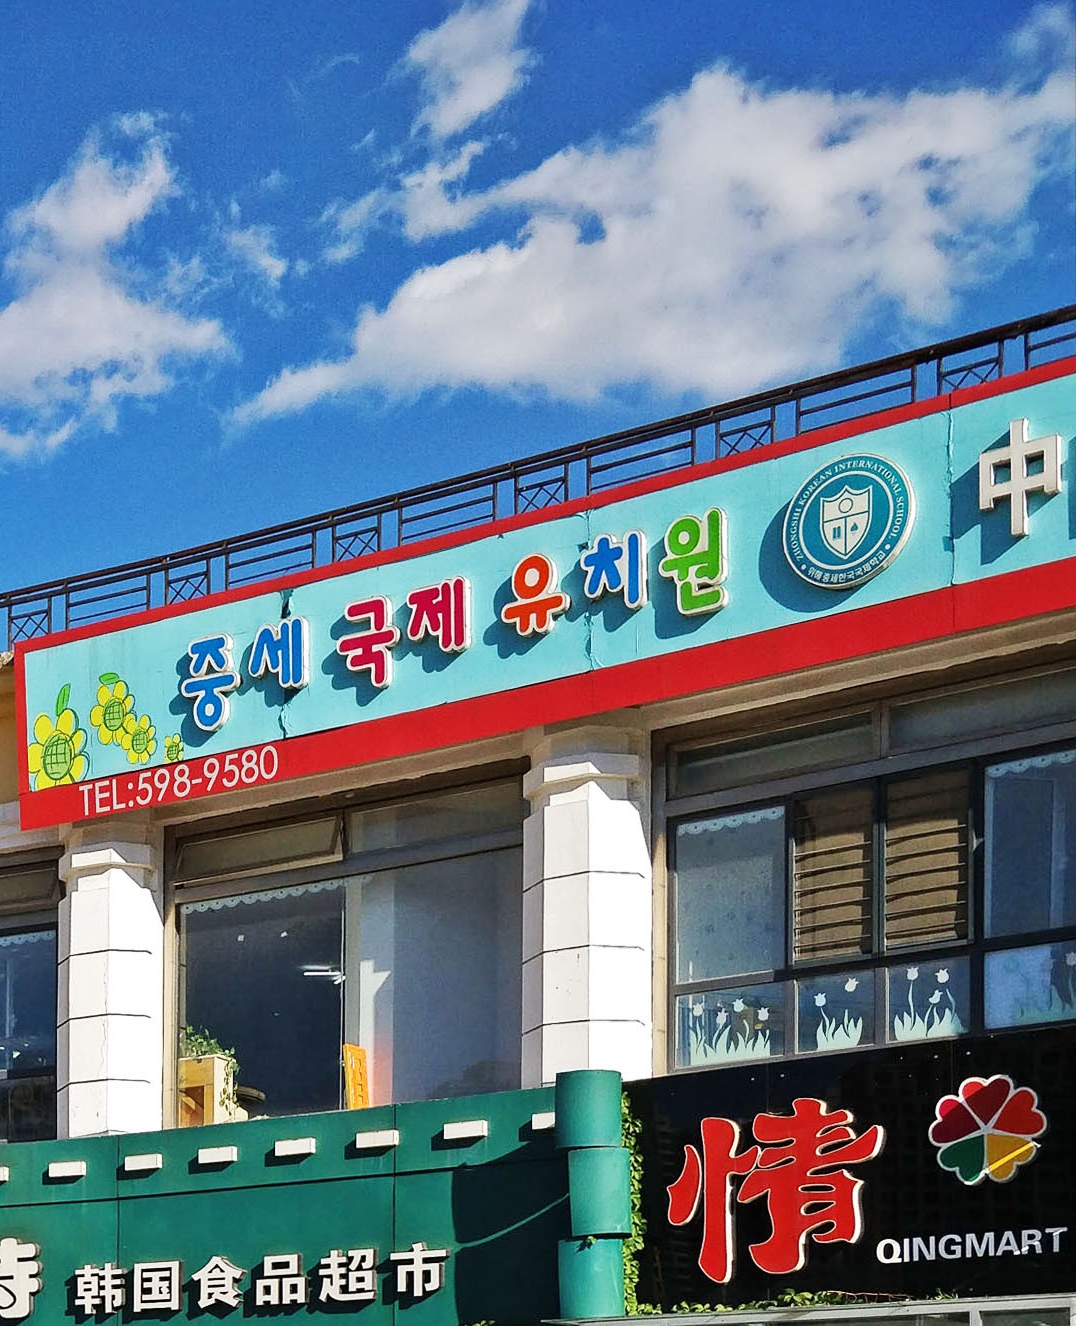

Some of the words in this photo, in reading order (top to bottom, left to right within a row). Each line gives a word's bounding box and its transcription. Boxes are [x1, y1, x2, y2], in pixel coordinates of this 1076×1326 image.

[800, 468, 832, 505] KOREAN
[834, 459, 902, 497] INTERNATIONAL
[892, 496, 905, 538] SCHOOL
[979, 418, 1062, 536] 中
[179, 616, 310, 732] 중세
[335, 575, 472, 689] 국제
[501, 506, 730, 638] 유치원
[79, 745, 279, 816] TEL:598-9580
[667, 1098, 885, 1284] 情
[74, 1242, 451, 1317] 韩国食品超市
[876, 1227, 1068, 1264] QINGMART
